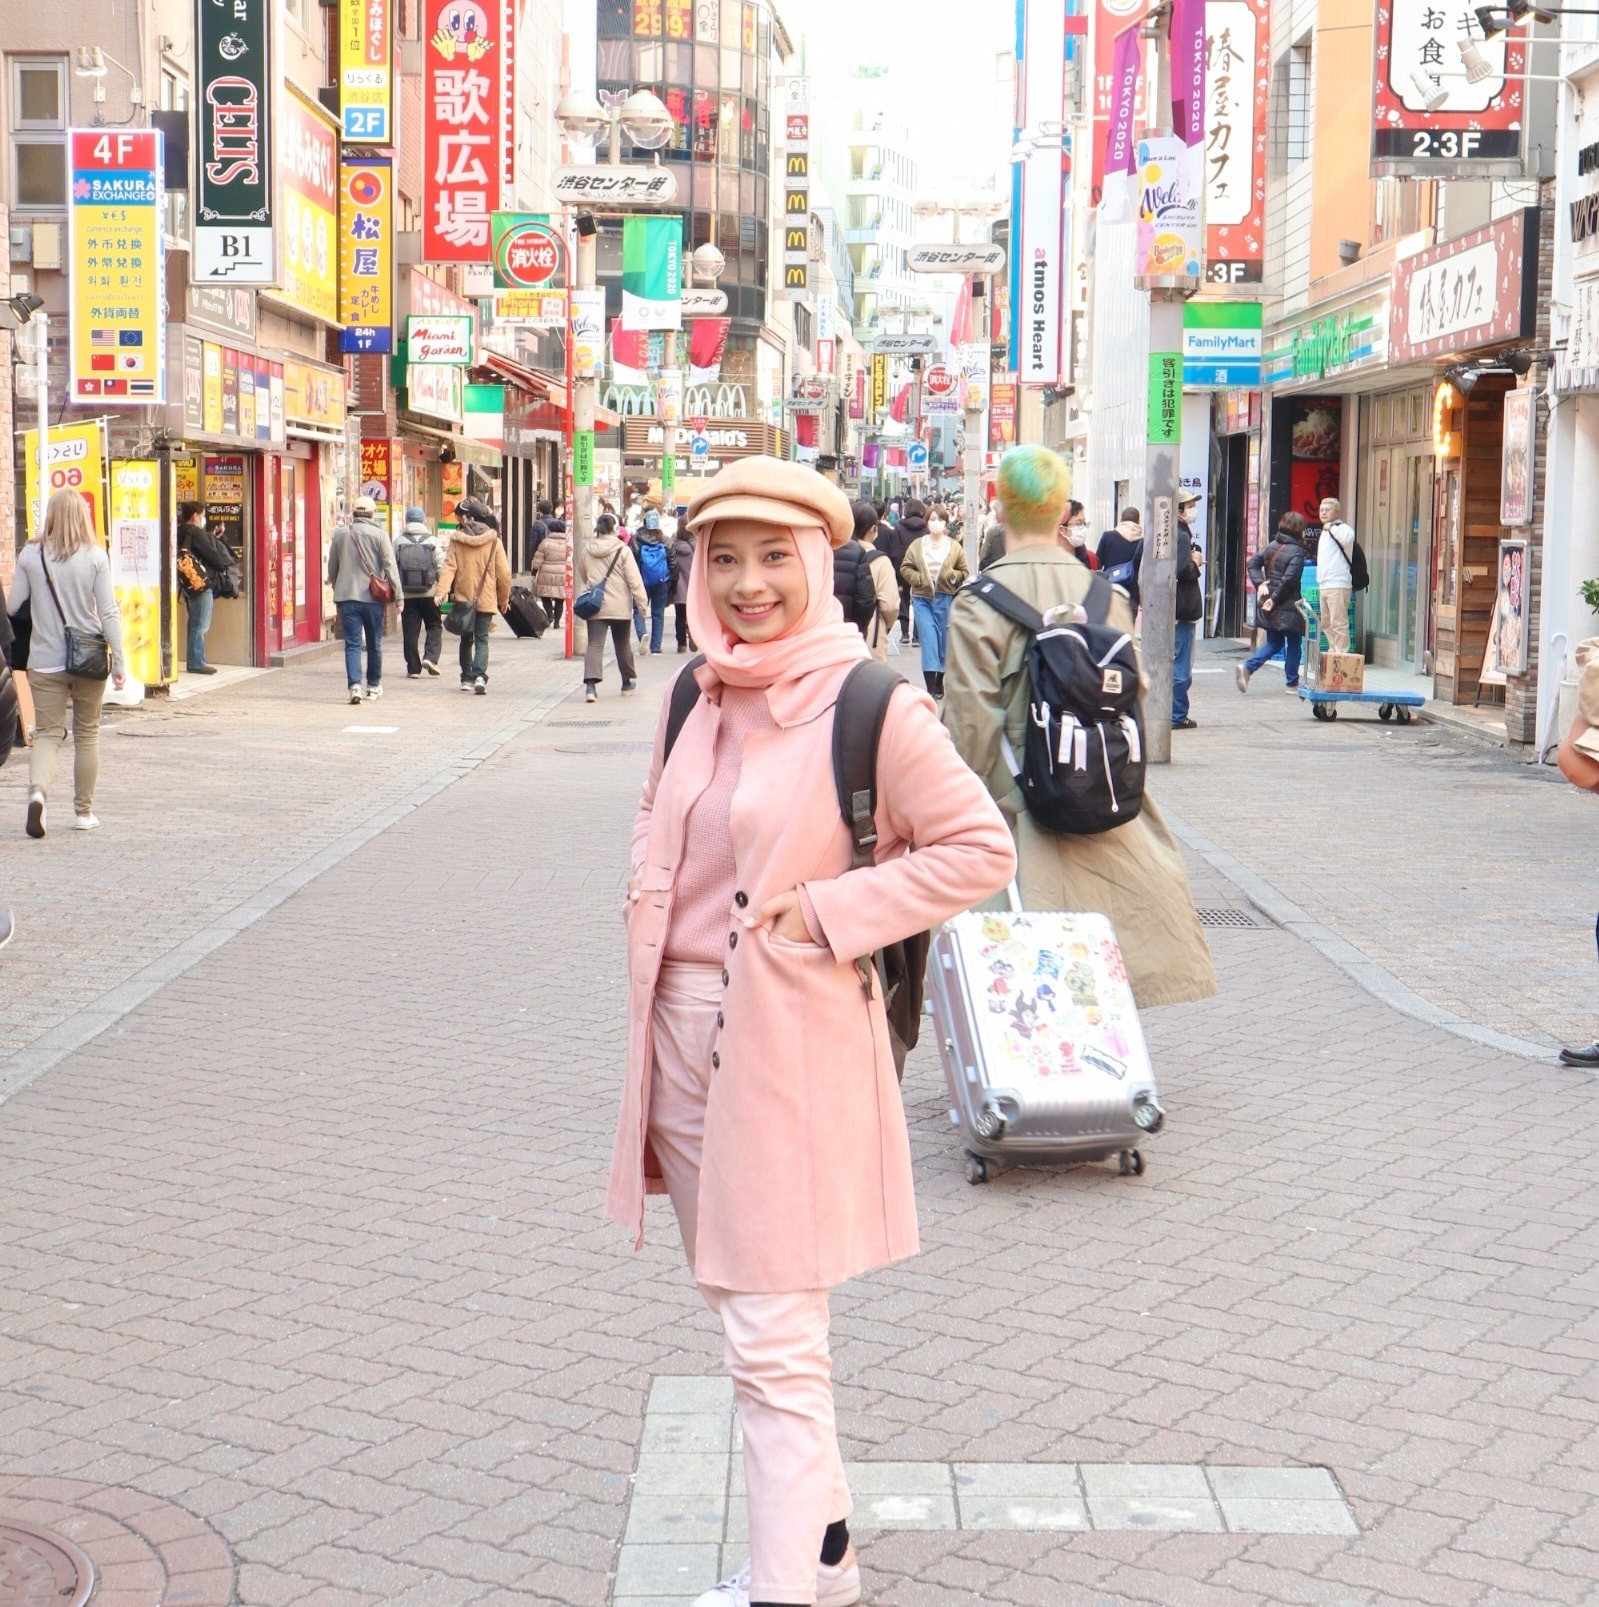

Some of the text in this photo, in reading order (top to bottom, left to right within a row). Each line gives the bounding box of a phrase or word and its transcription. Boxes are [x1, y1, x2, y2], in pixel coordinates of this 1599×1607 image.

[1418, 6, 1447, 87] お食
[1191, 27, 1203, 132] TOKYO 2020
[350, 112, 381, 133] 2F
[1114, 65, 1135, 161] TOKYO 2020
[206, 75, 259, 186] CELTS
[434, 68, 491, 248] 歌広場
[93, 180, 155, 191] SAKURA
[557, 175, 668, 191] 渋谷センター街
[114, 225, 142, 234] exchange
[220, 234, 252, 257] B1
[350, 213, 380, 276] 松屋
[511, 247, 554, 268] 消火栓
[914, 251, 1000, 263] 渋谷センター街
[666, 240, 678, 295] TOKYO 2020
[91, 306, 139, 319] 外貨両替
[350, 295, 360, 322] 定食
[361, 289, 370, 318] カレー
[370, 285, 380, 314] 牛めし
[1032, 247, 1048, 370] atmos Heart
[355, 328, 376, 336] 24h
[1188, 335, 1256, 350] FamilyMart
[1292, 312, 1352, 380] FamilyMart
[1215, 369, 1228, 383] 酒
[1162, 358, 1175, 438] 客引きは犯罪です
